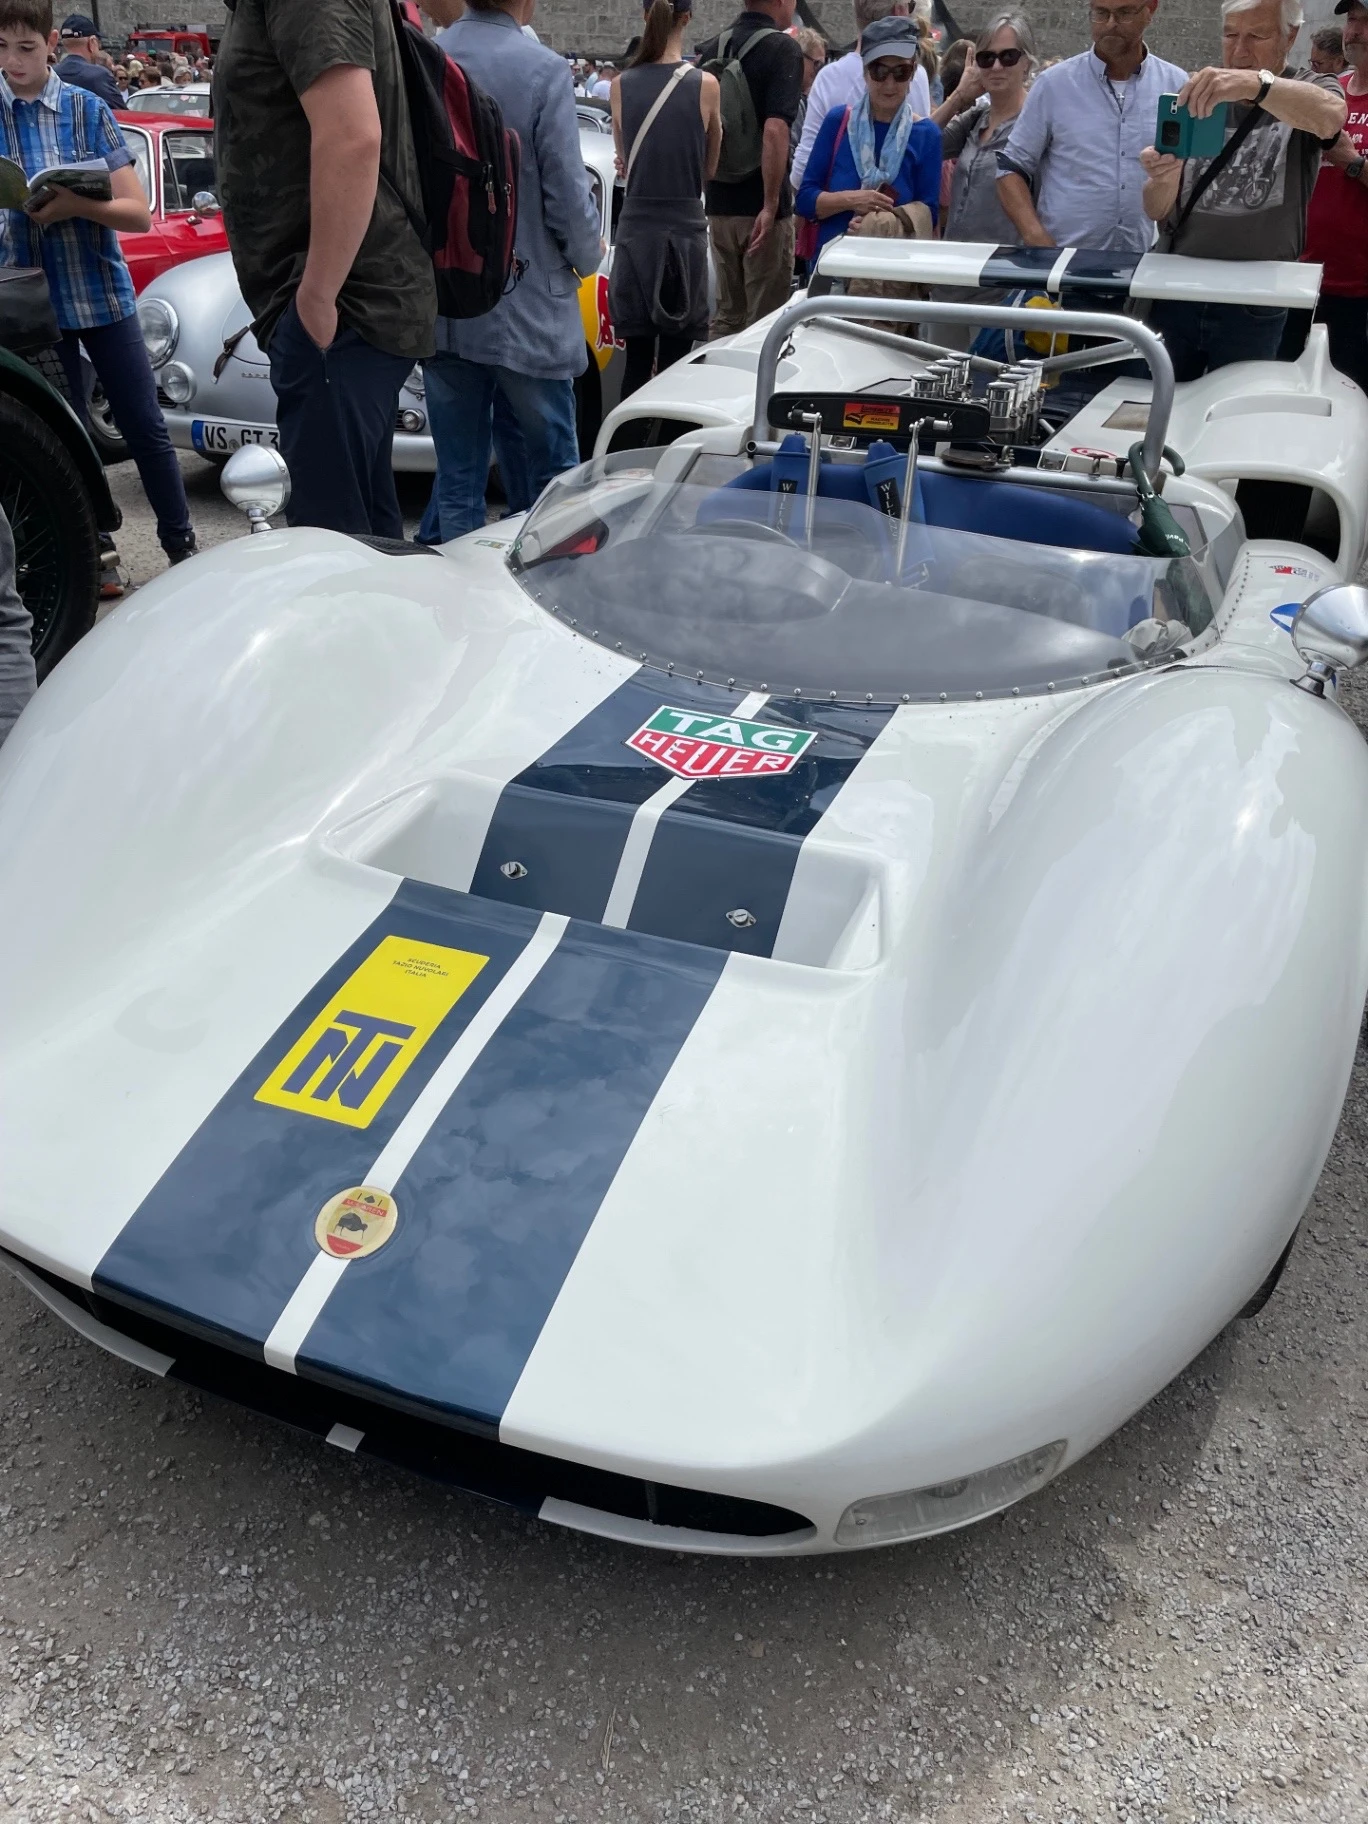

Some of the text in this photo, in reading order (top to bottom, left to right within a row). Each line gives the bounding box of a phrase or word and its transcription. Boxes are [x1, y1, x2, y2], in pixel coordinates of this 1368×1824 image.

[205, 425, 228, 449] VS
[669, 712, 798, 751] TAG
[638, 732, 786, 774] HEUER
[392, 960, 413, 968] TAZIO
[407, 958, 441, 969] SCUDERIA
[404, 969, 427, 977] ITALIA
